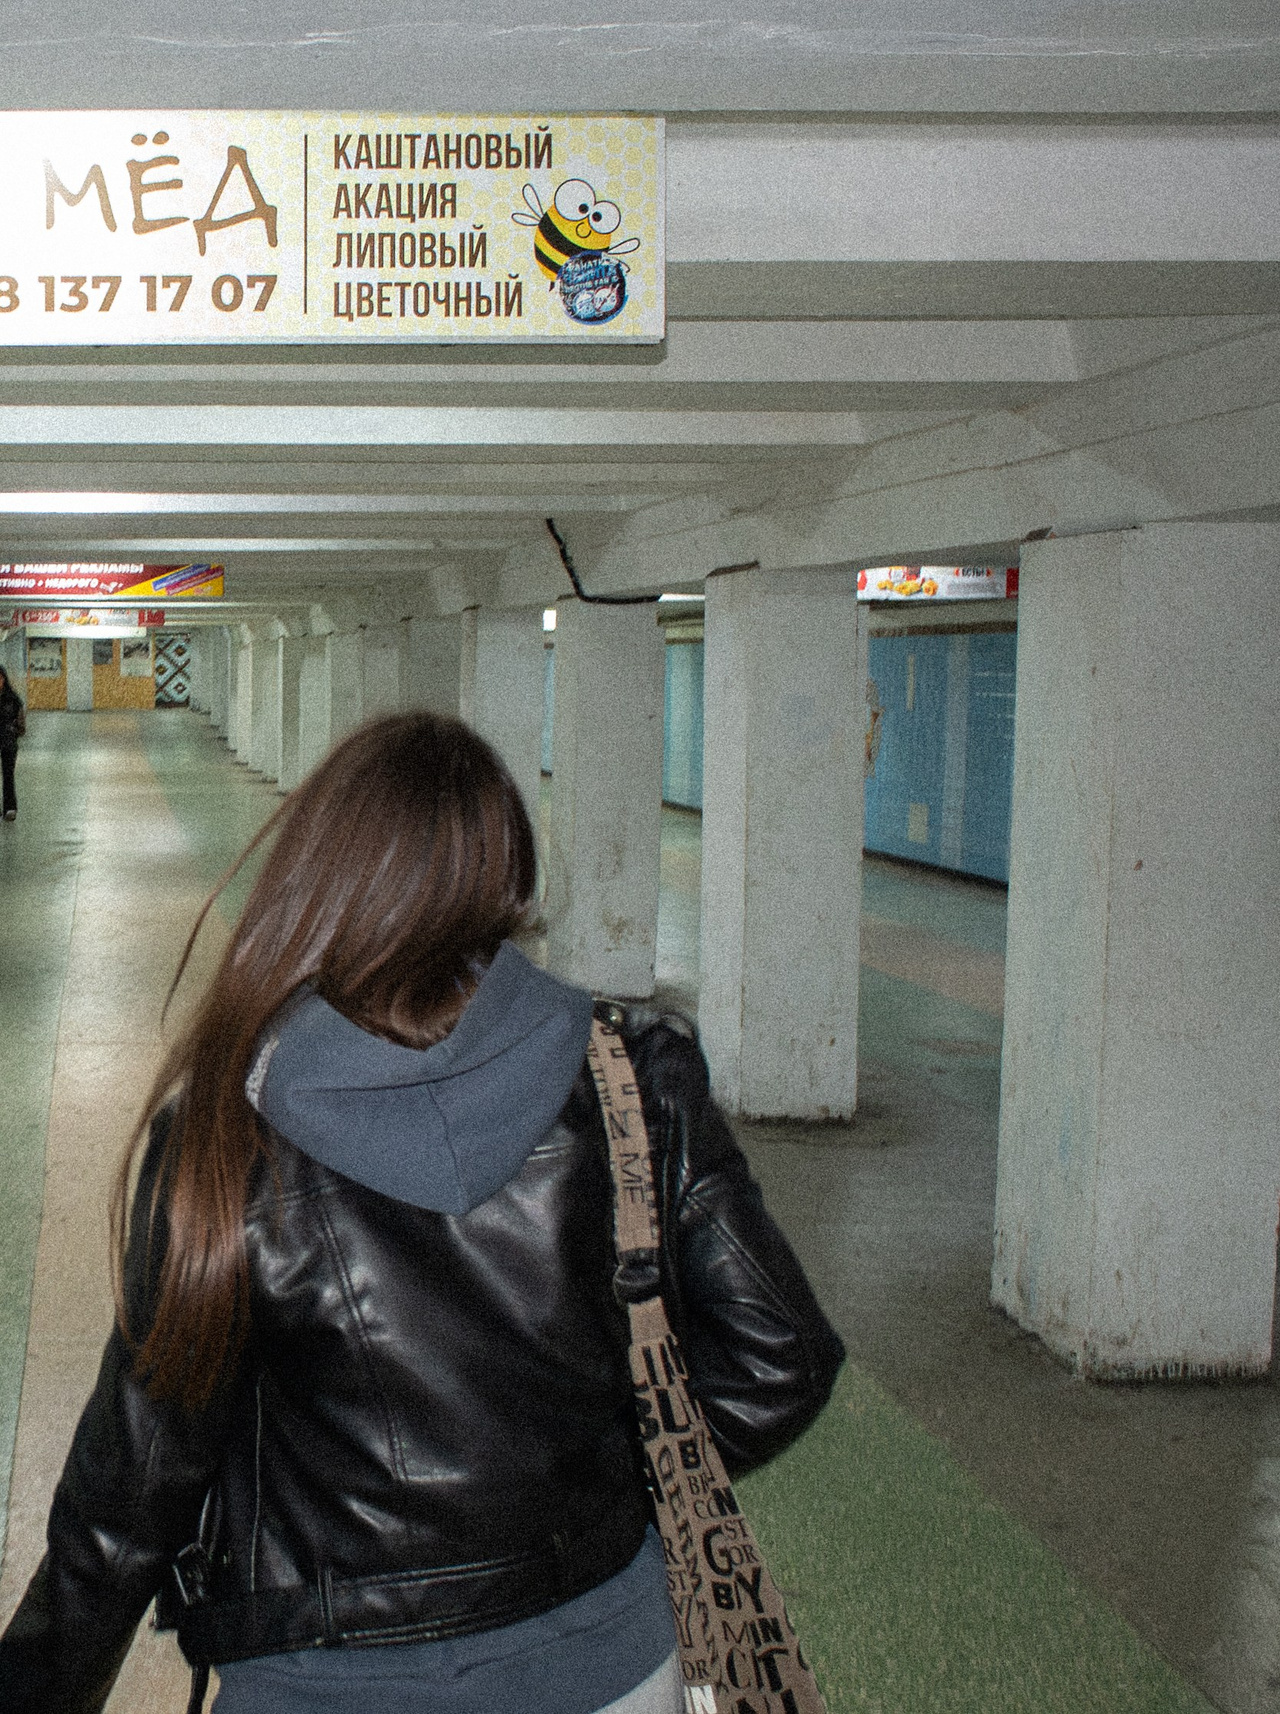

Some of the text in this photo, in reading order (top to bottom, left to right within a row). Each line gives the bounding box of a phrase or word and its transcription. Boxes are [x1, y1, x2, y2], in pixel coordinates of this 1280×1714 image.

[333, 125, 554, 170] КАШТАНОВЫЙ
[44, 129, 280, 258] МЁД
[332, 183, 458, 224] АКАЦИЯ
[332, 225, 488, 268] ЛИПОВЫЙ
[37, 275, 123, 314] 137
[138, 274, 193, 314] 17
[209, 273, 280, 314] 07
[332, 273, 523, 322] ЦВЕТОЧНЫЙ
[45, 577, 100, 590] НЕДОРОГО
